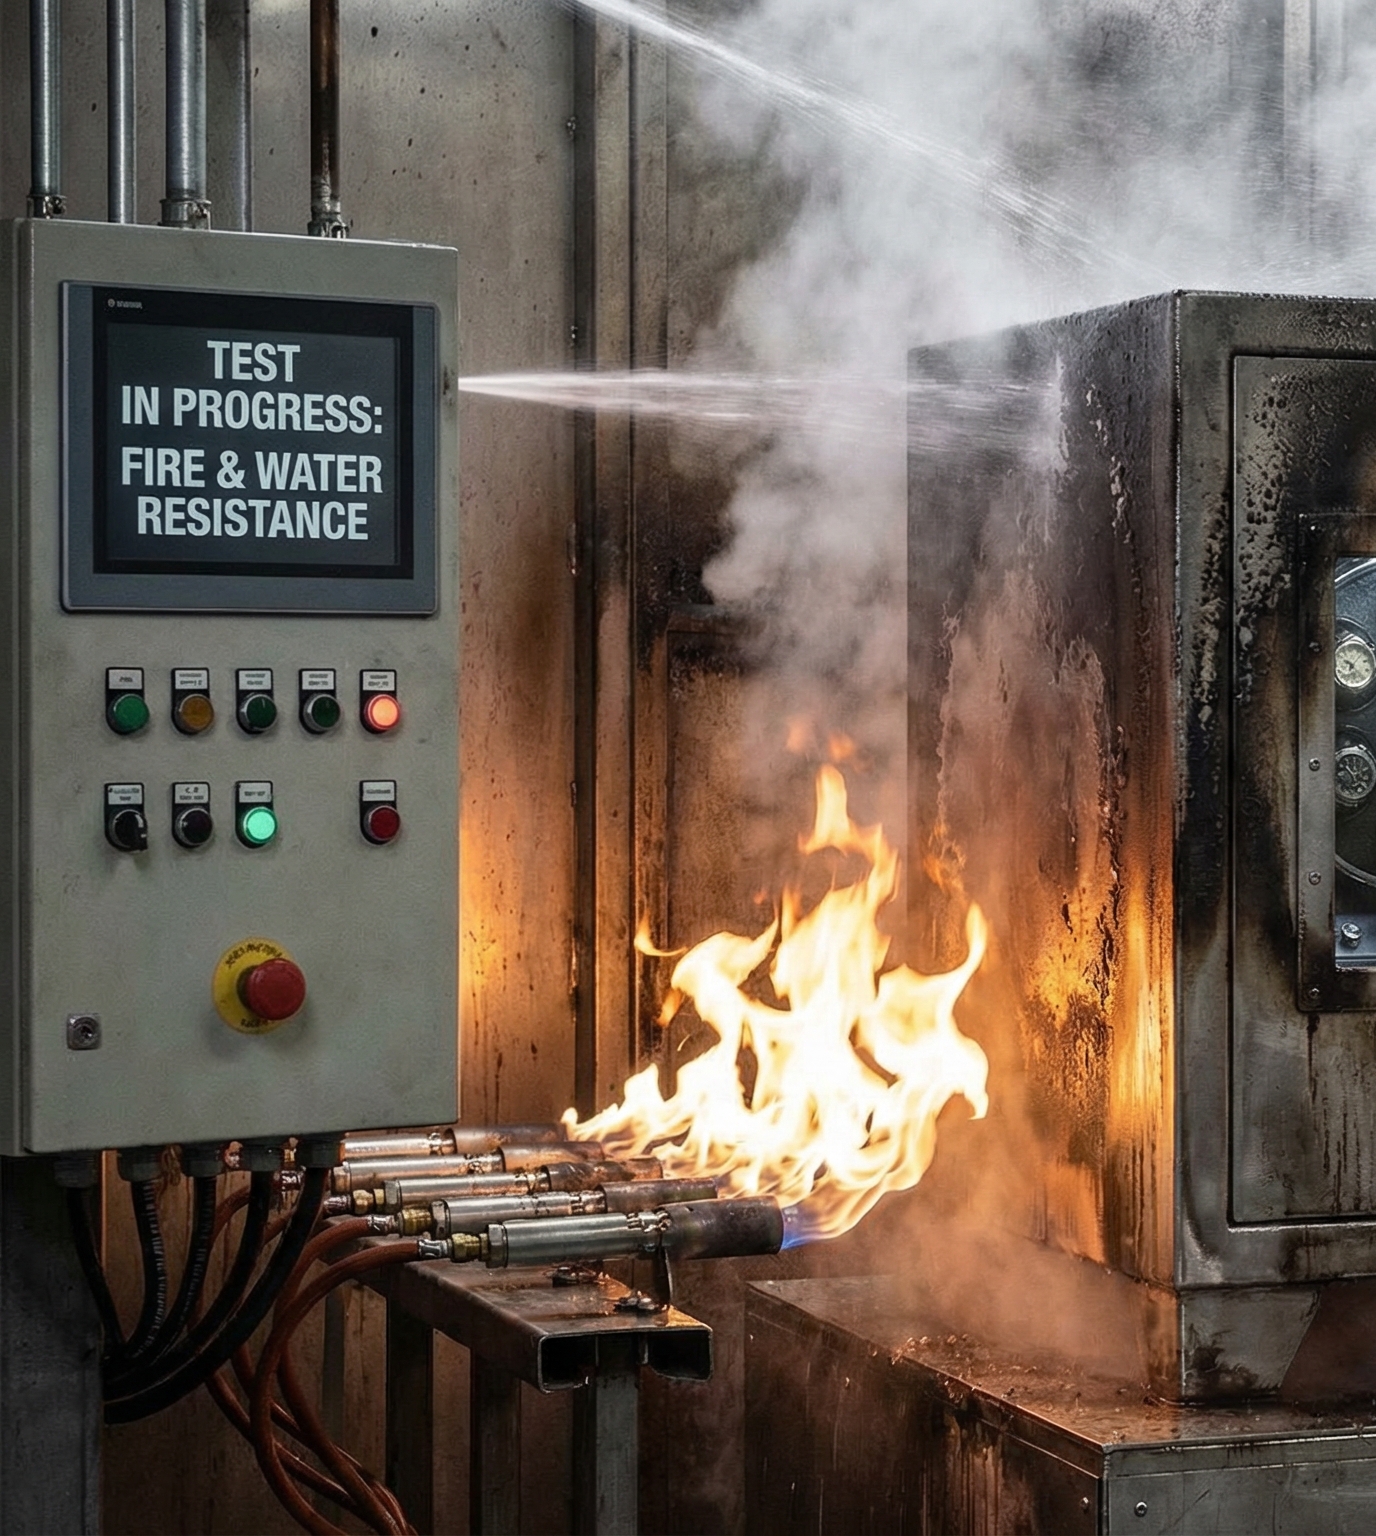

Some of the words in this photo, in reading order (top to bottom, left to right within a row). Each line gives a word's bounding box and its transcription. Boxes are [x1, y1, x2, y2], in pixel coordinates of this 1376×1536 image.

[207, 341, 300, 382] TEST
[123, 386, 159, 424] IN
[174, 388, 382, 433] PROGRESS:
[123, 447, 205, 487] FIRE
[217, 451, 245, 488] &
[255, 452, 382, 493] WATER
[138, 496, 368, 539] RESISTANCE
